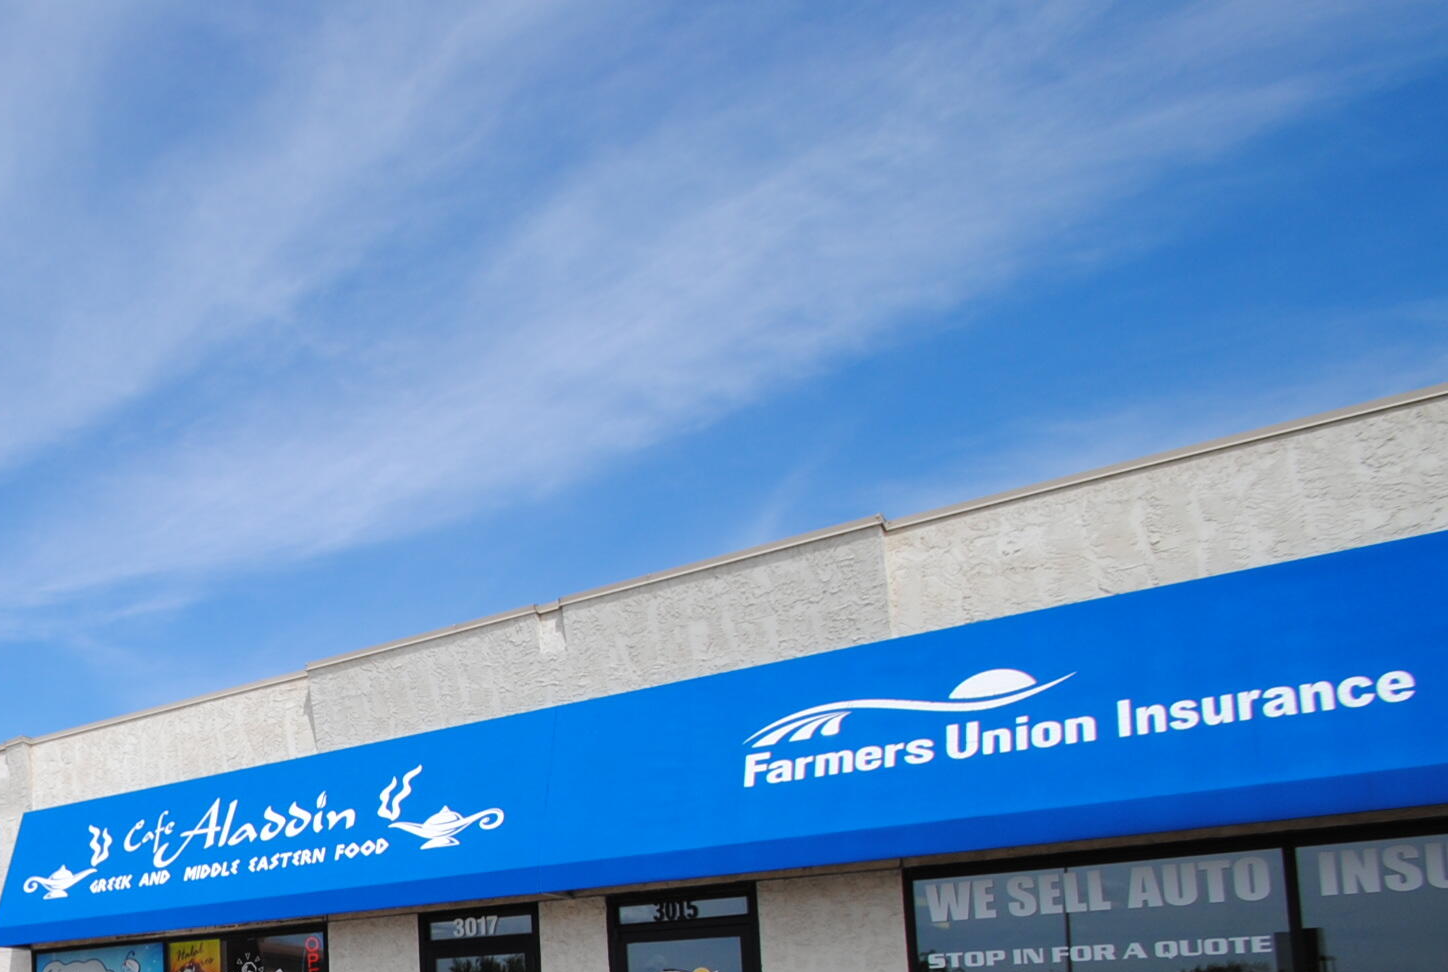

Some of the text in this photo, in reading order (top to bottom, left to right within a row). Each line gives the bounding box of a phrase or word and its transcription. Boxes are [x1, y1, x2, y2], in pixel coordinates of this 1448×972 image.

[743, 669, 1417, 788] Farmers Union Insurance
[153, 790, 356, 869] Aladdin
[89, 837, 389, 894] GREEK AND MIDDLE EASTERN FOOD
[925, 879, 997, 923] WE
[1006, 869, 1112, 917] SELL
[1127, 856, 1271, 909] AUTO
[453, 915, 498, 937] 3017
[653, 900, 699, 921] 3015
[927, 935, 1273, 969] STOP IN FOR A QUOTE
